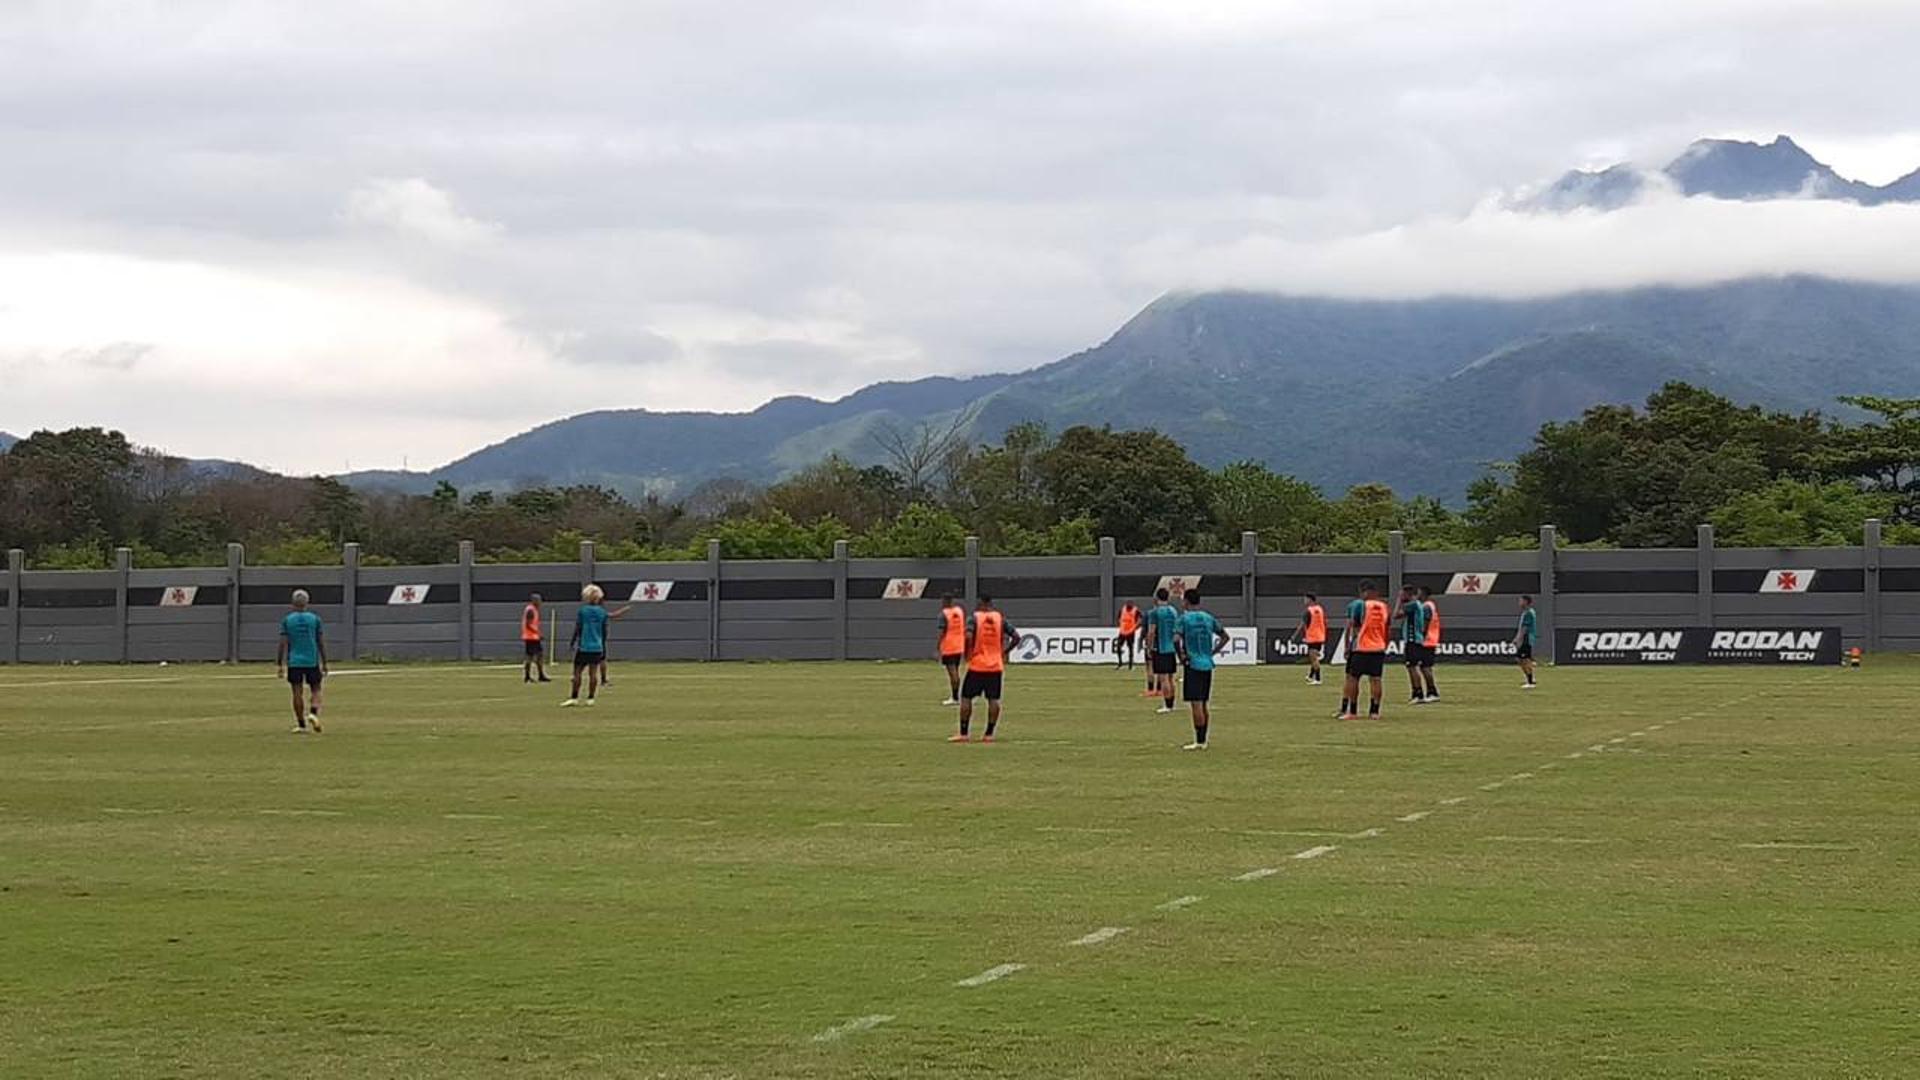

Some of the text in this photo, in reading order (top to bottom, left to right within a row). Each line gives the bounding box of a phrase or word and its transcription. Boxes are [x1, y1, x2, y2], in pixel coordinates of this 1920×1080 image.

[1047, 637, 1125, 654] FORTE
[1466, 641, 1517, 654] conta
[1574, 631, 1683, 650] RODAN
[1710, 631, 1822, 649] RODAN
[1640, 651, 1676, 661] TECH
[1779, 651, 1815, 660] TECH
